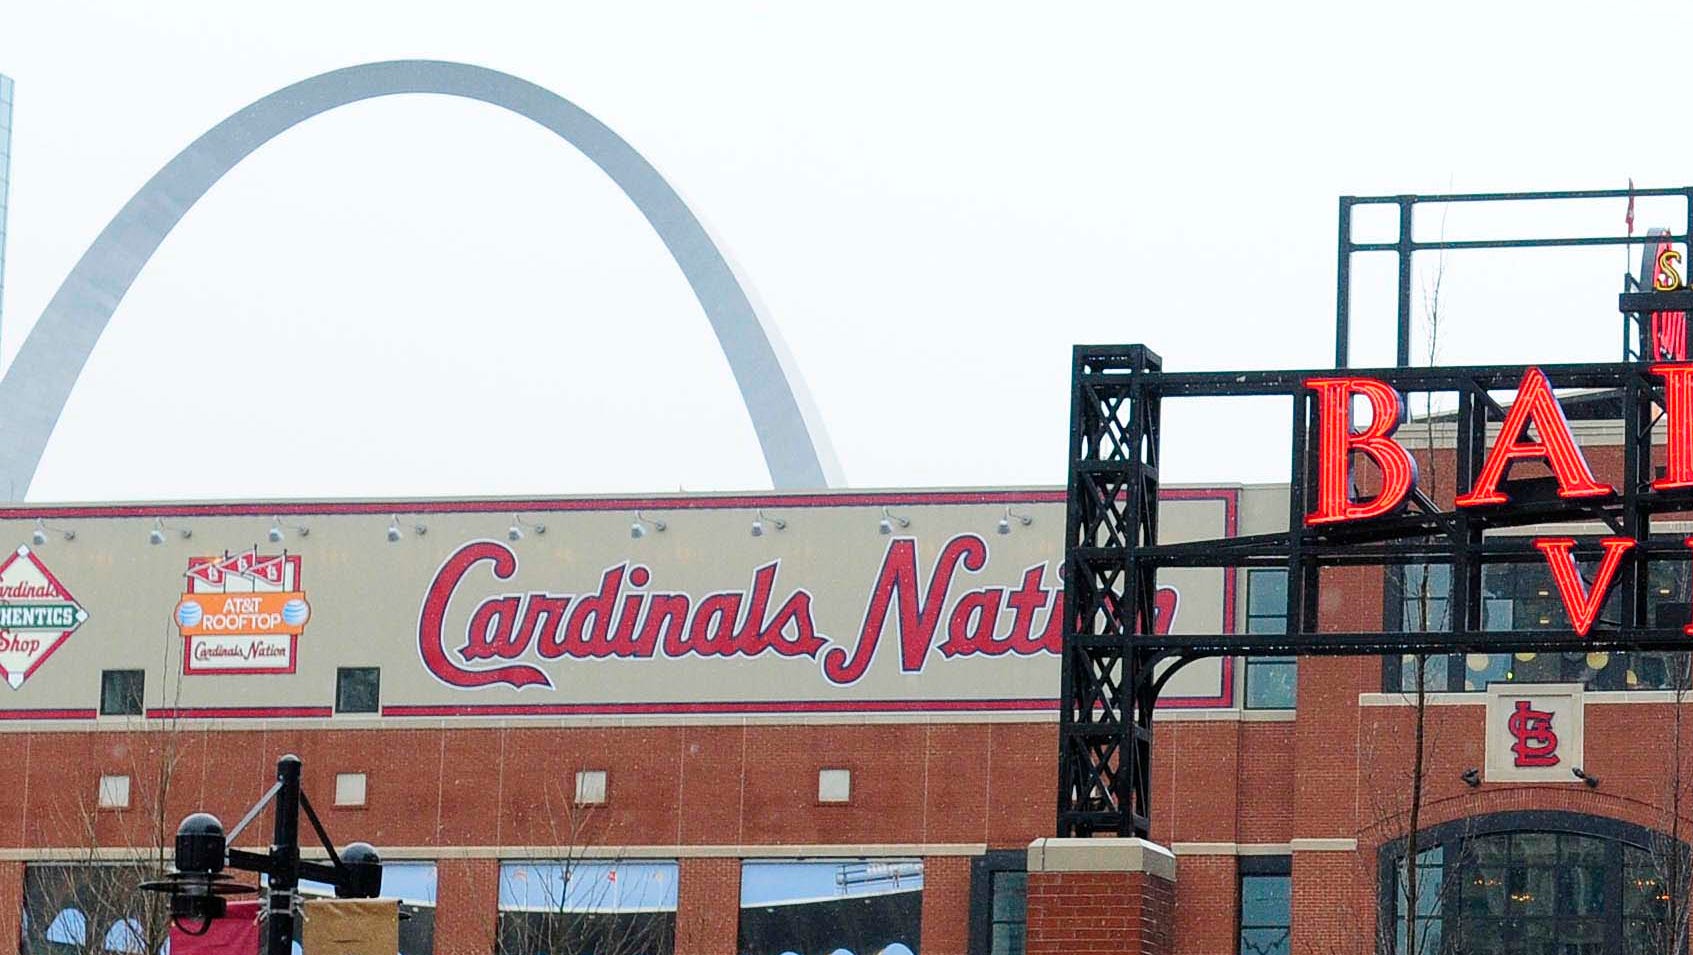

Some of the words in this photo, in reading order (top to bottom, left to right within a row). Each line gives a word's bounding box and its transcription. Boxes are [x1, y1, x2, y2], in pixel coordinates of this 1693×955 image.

[222, 597, 263, 614] AT&T
[415, 539, 829, 690] Cardinals
[821, 533, 1180, 687] Nati
[201, 613, 282, 631] ROOFTOP
[194, 640, 244, 661] Cardinals
[243, 640, 286, 660] Nation
